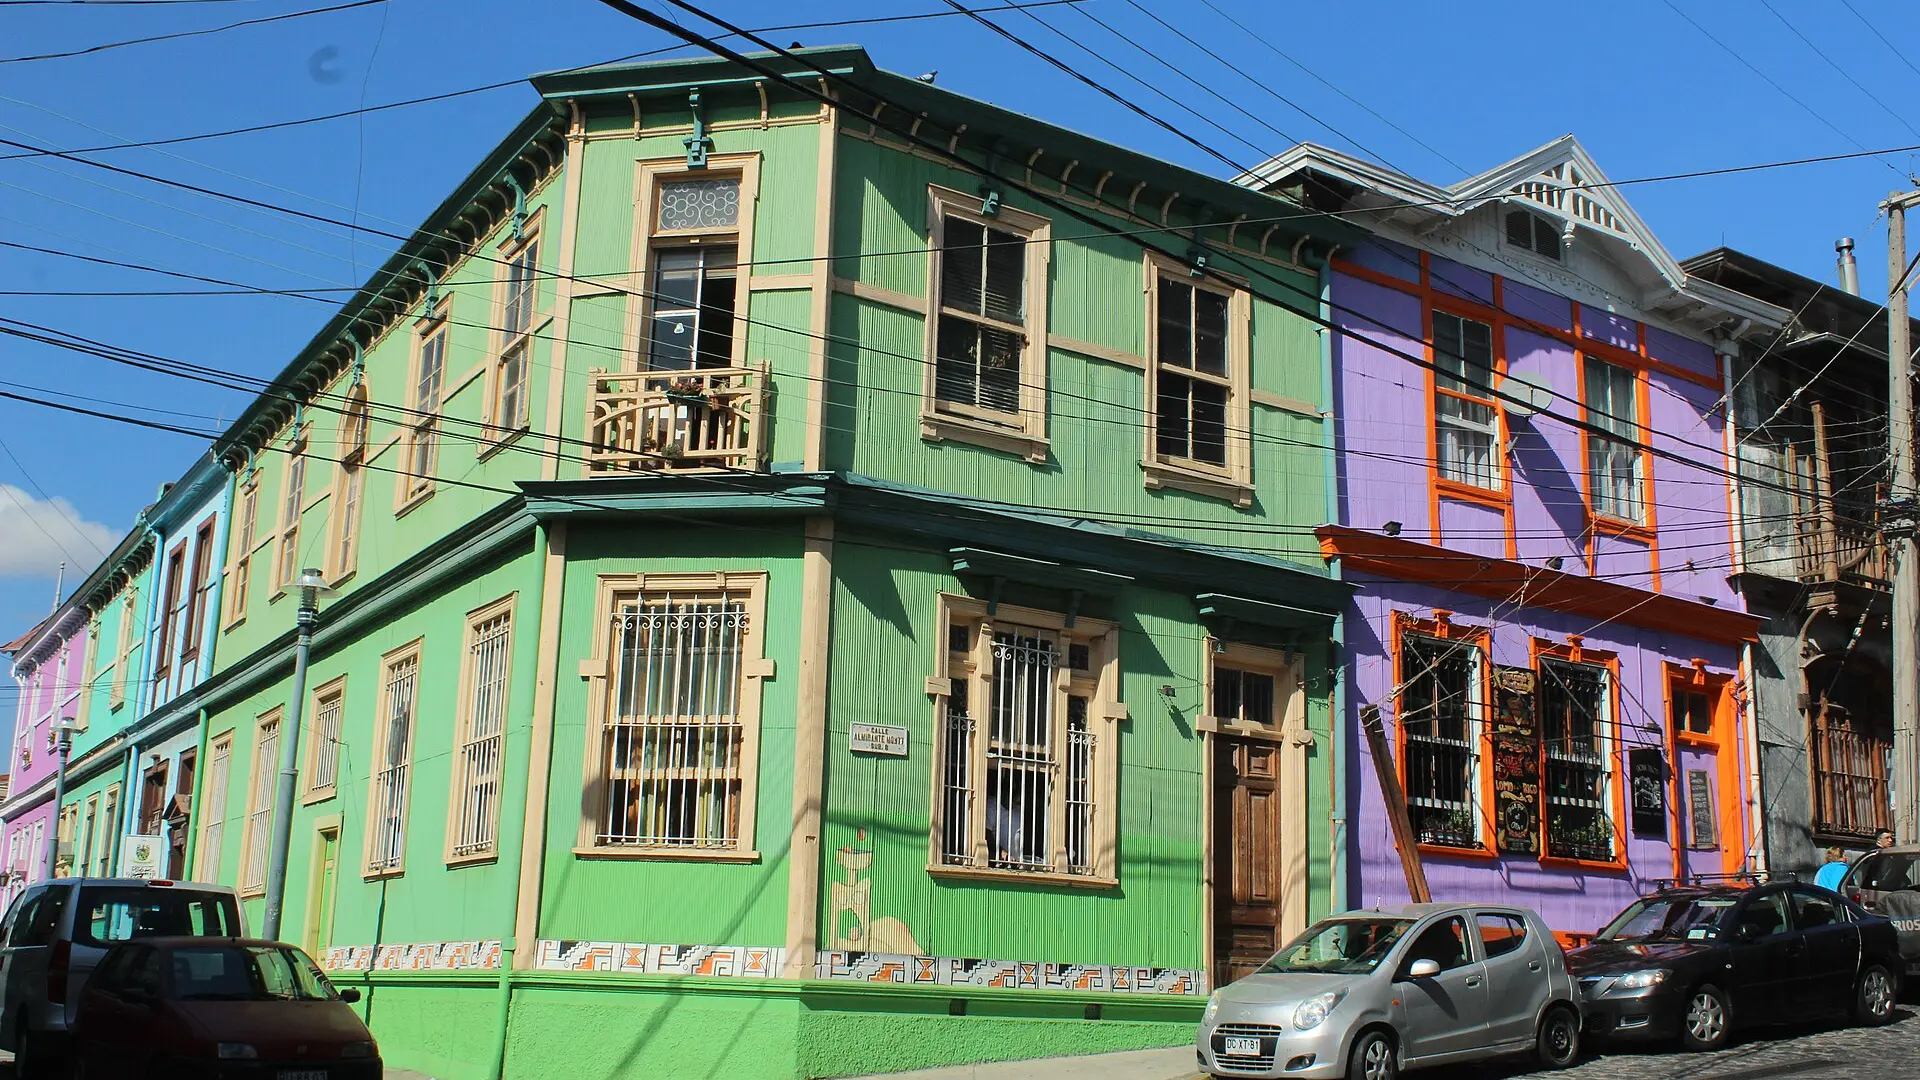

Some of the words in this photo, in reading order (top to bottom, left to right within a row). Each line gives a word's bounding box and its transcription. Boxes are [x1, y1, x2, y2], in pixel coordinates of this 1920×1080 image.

[871, 727, 888, 735] CALLE
[854, 733, 885, 743] ALMIRANTE
[1495, 780, 1513, 791] LOMO
